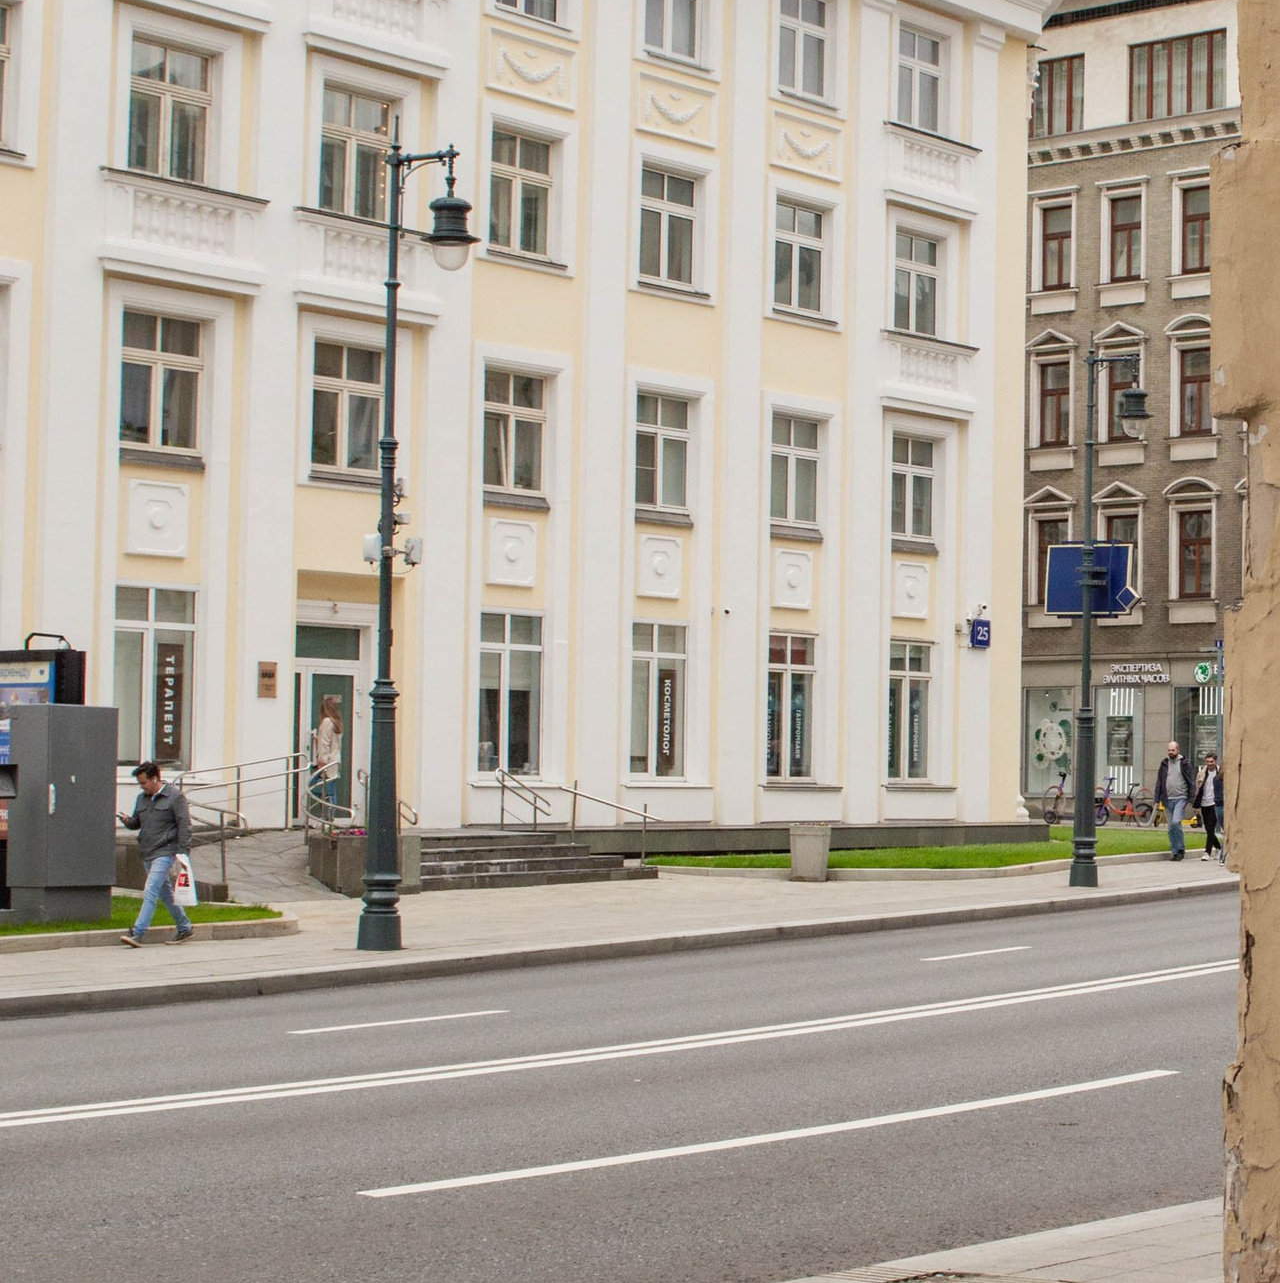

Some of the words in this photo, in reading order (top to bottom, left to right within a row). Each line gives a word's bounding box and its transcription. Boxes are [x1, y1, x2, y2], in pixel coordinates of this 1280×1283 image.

[976, 626, 989, 641] 25
[1110, 663, 1162, 673] ЭКСПЕРТИЗА
[1103, 674, 1140, 684] ЭЛИТНЫХ
[1141, 673, 1170, 683] ЧАСОВ
[164, 655, 174, 745] ТЕРАПЕВТ
[663, 678, 671, 757] КОСМЕТОЛОГ
